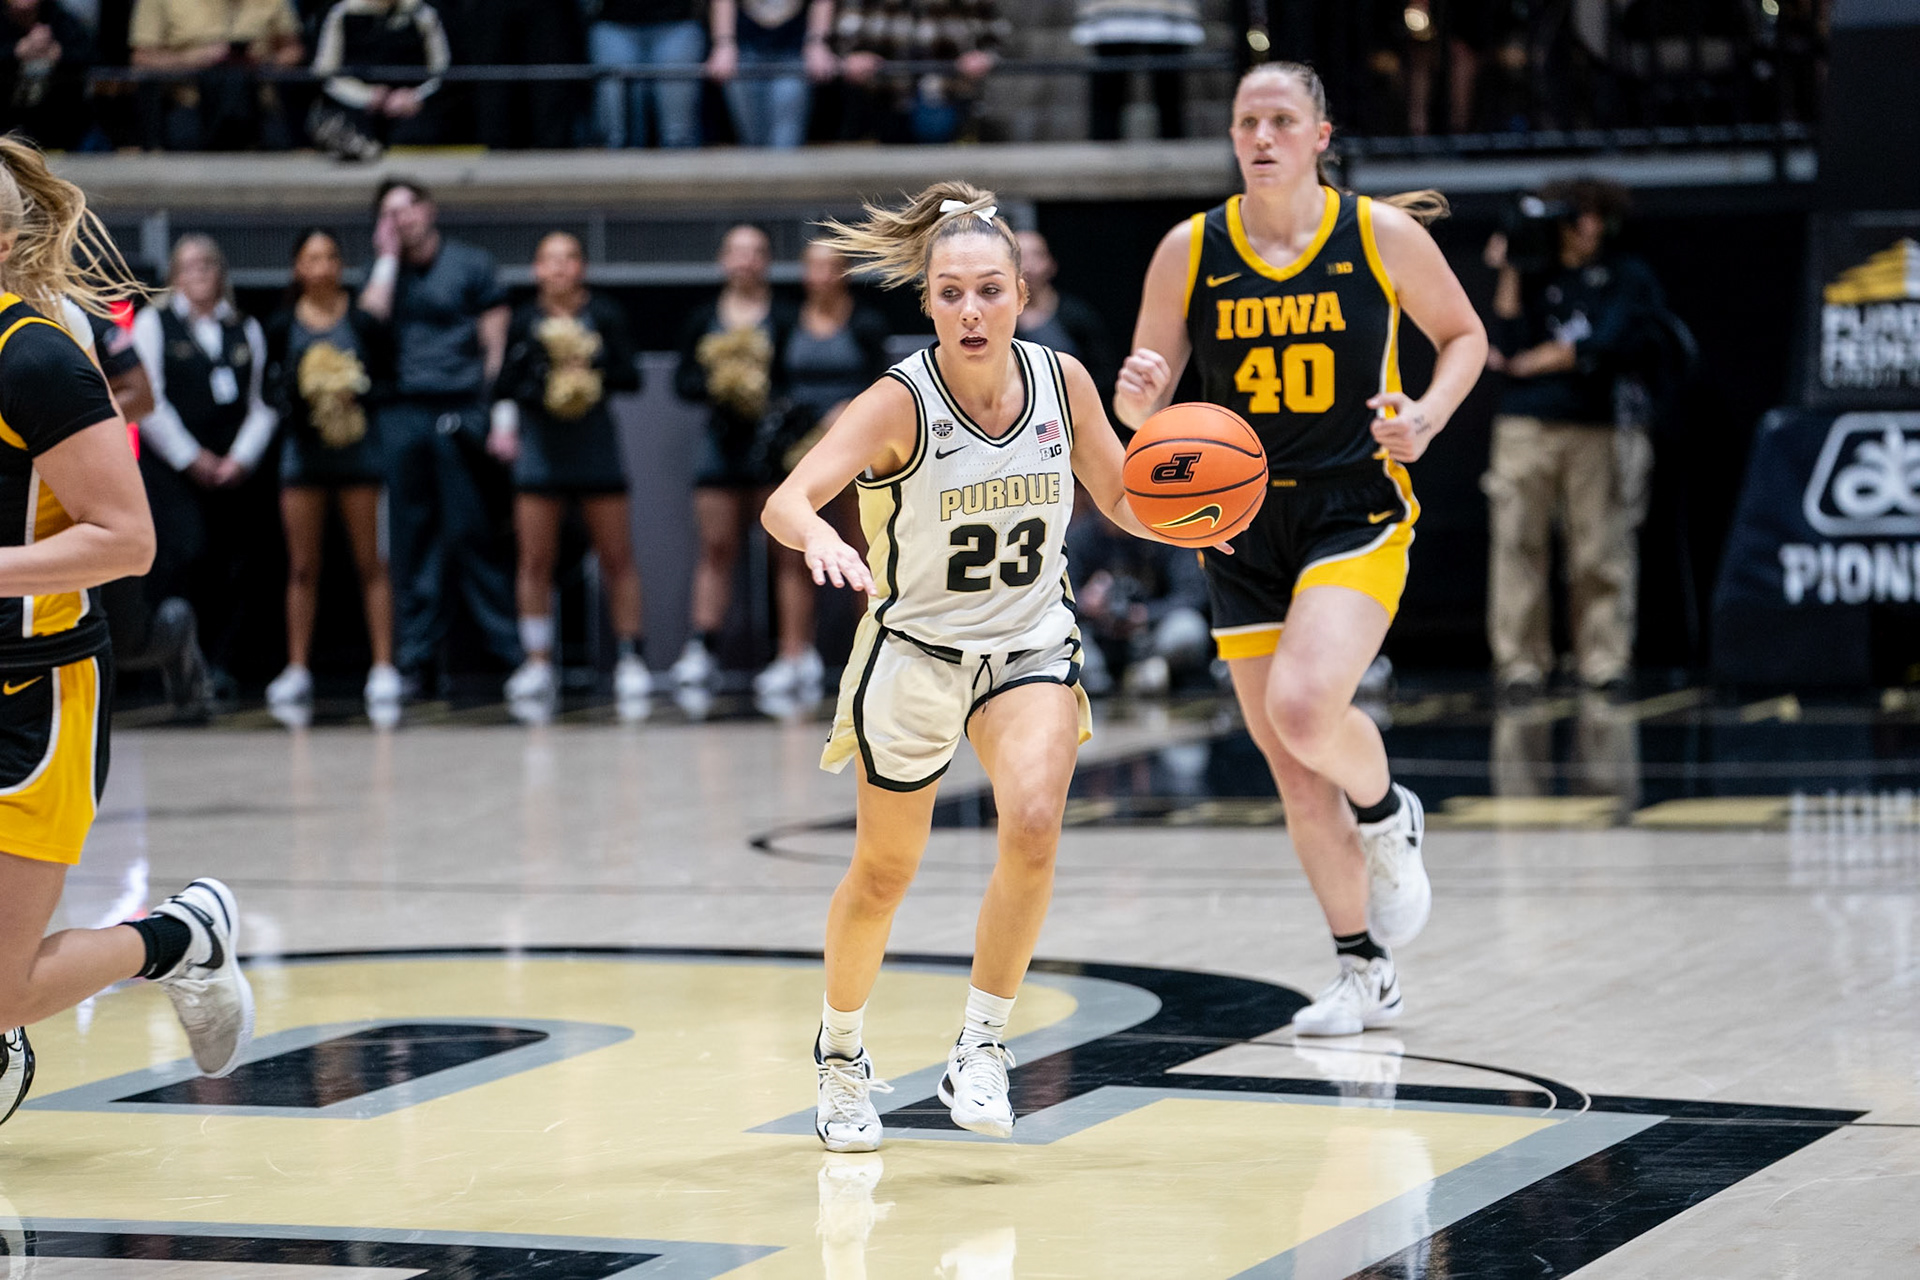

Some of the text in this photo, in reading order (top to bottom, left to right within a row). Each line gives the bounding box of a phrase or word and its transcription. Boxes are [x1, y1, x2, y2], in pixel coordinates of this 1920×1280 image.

[1216, 291, 1346, 340] IOWA
[1234, 343, 1335, 414] 40
[940, 472, 1060, 521] PURDUE
[946, 517, 1046, 592] 23
